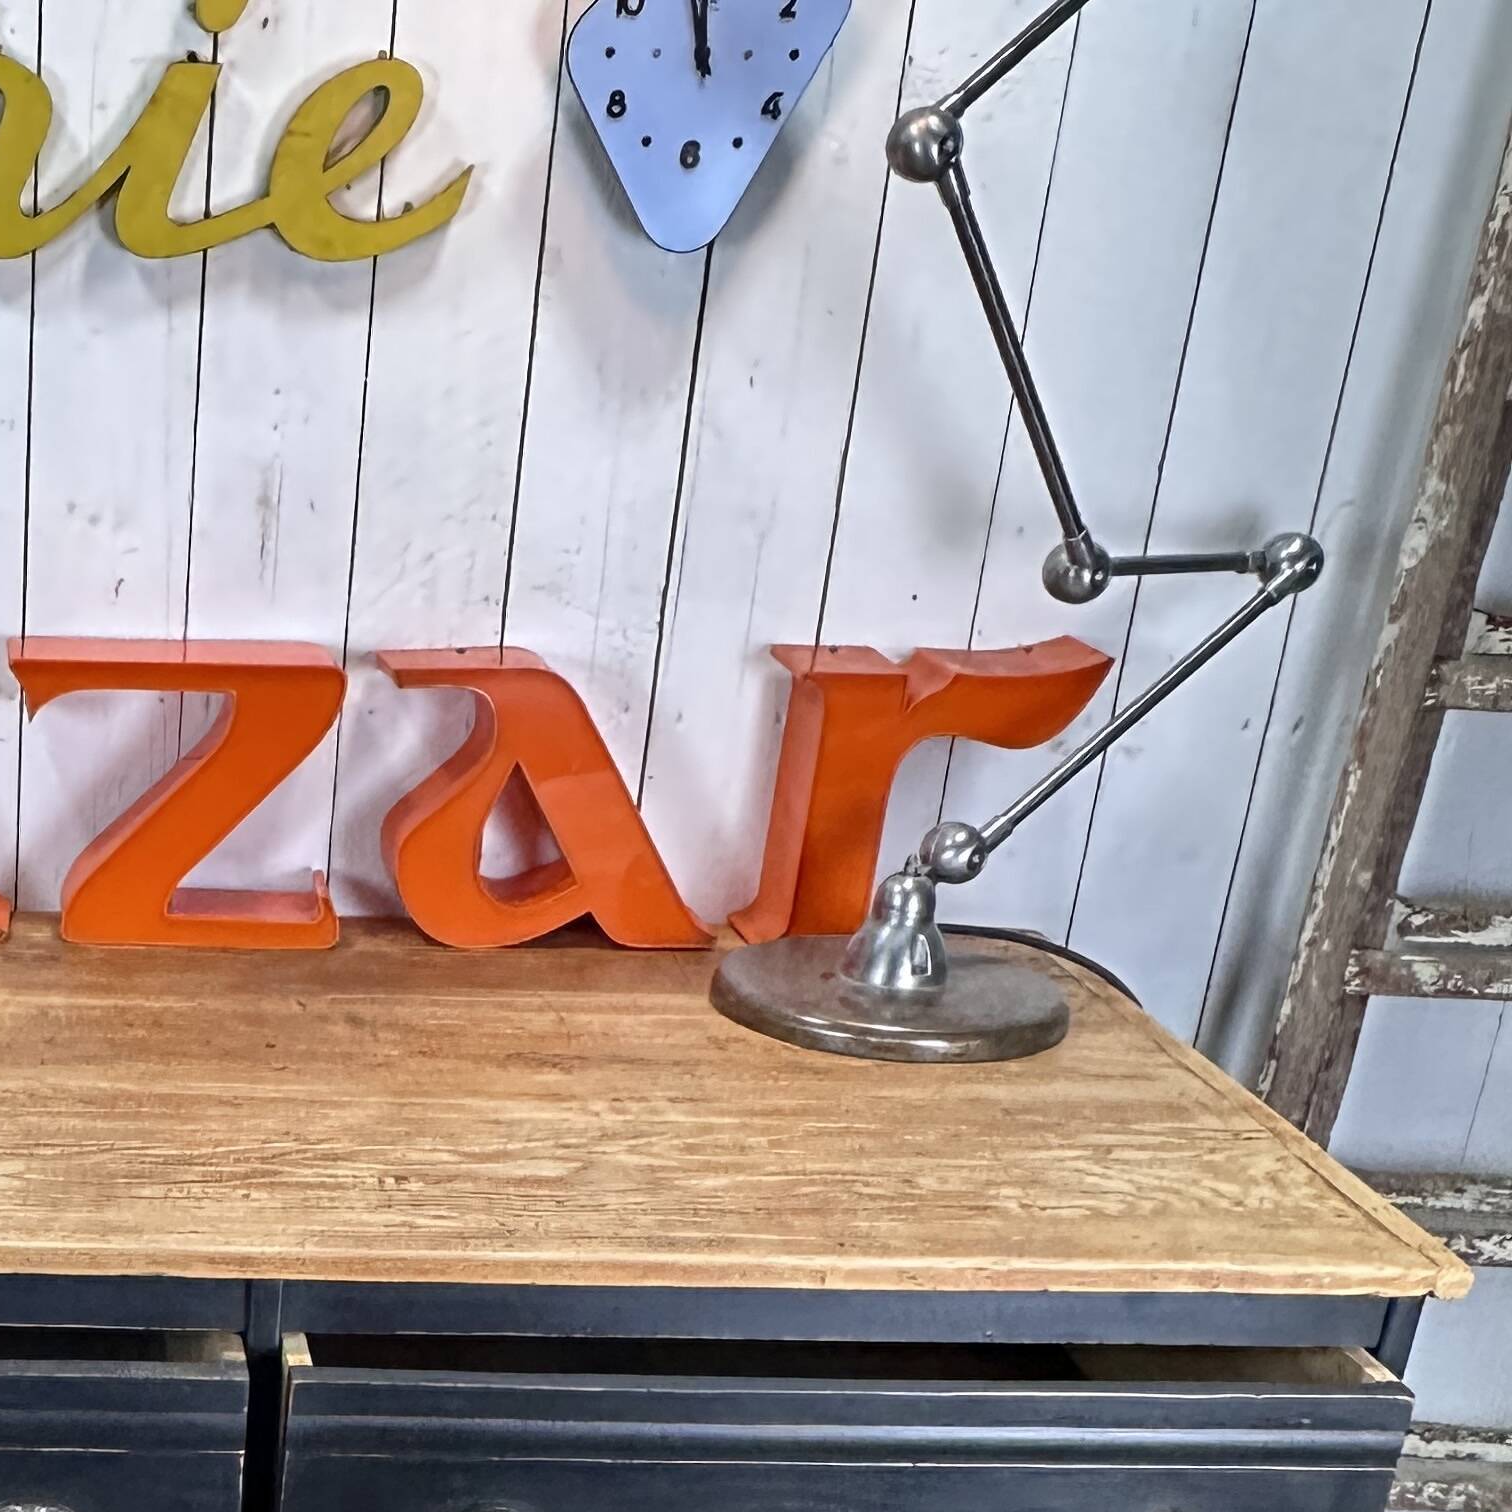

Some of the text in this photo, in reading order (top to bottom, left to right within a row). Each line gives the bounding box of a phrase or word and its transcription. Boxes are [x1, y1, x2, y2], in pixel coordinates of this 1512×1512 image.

[606, 90, 627, 118] 8
[761, 92, 784, 120] 4
[679, 140, 701, 169] 6
